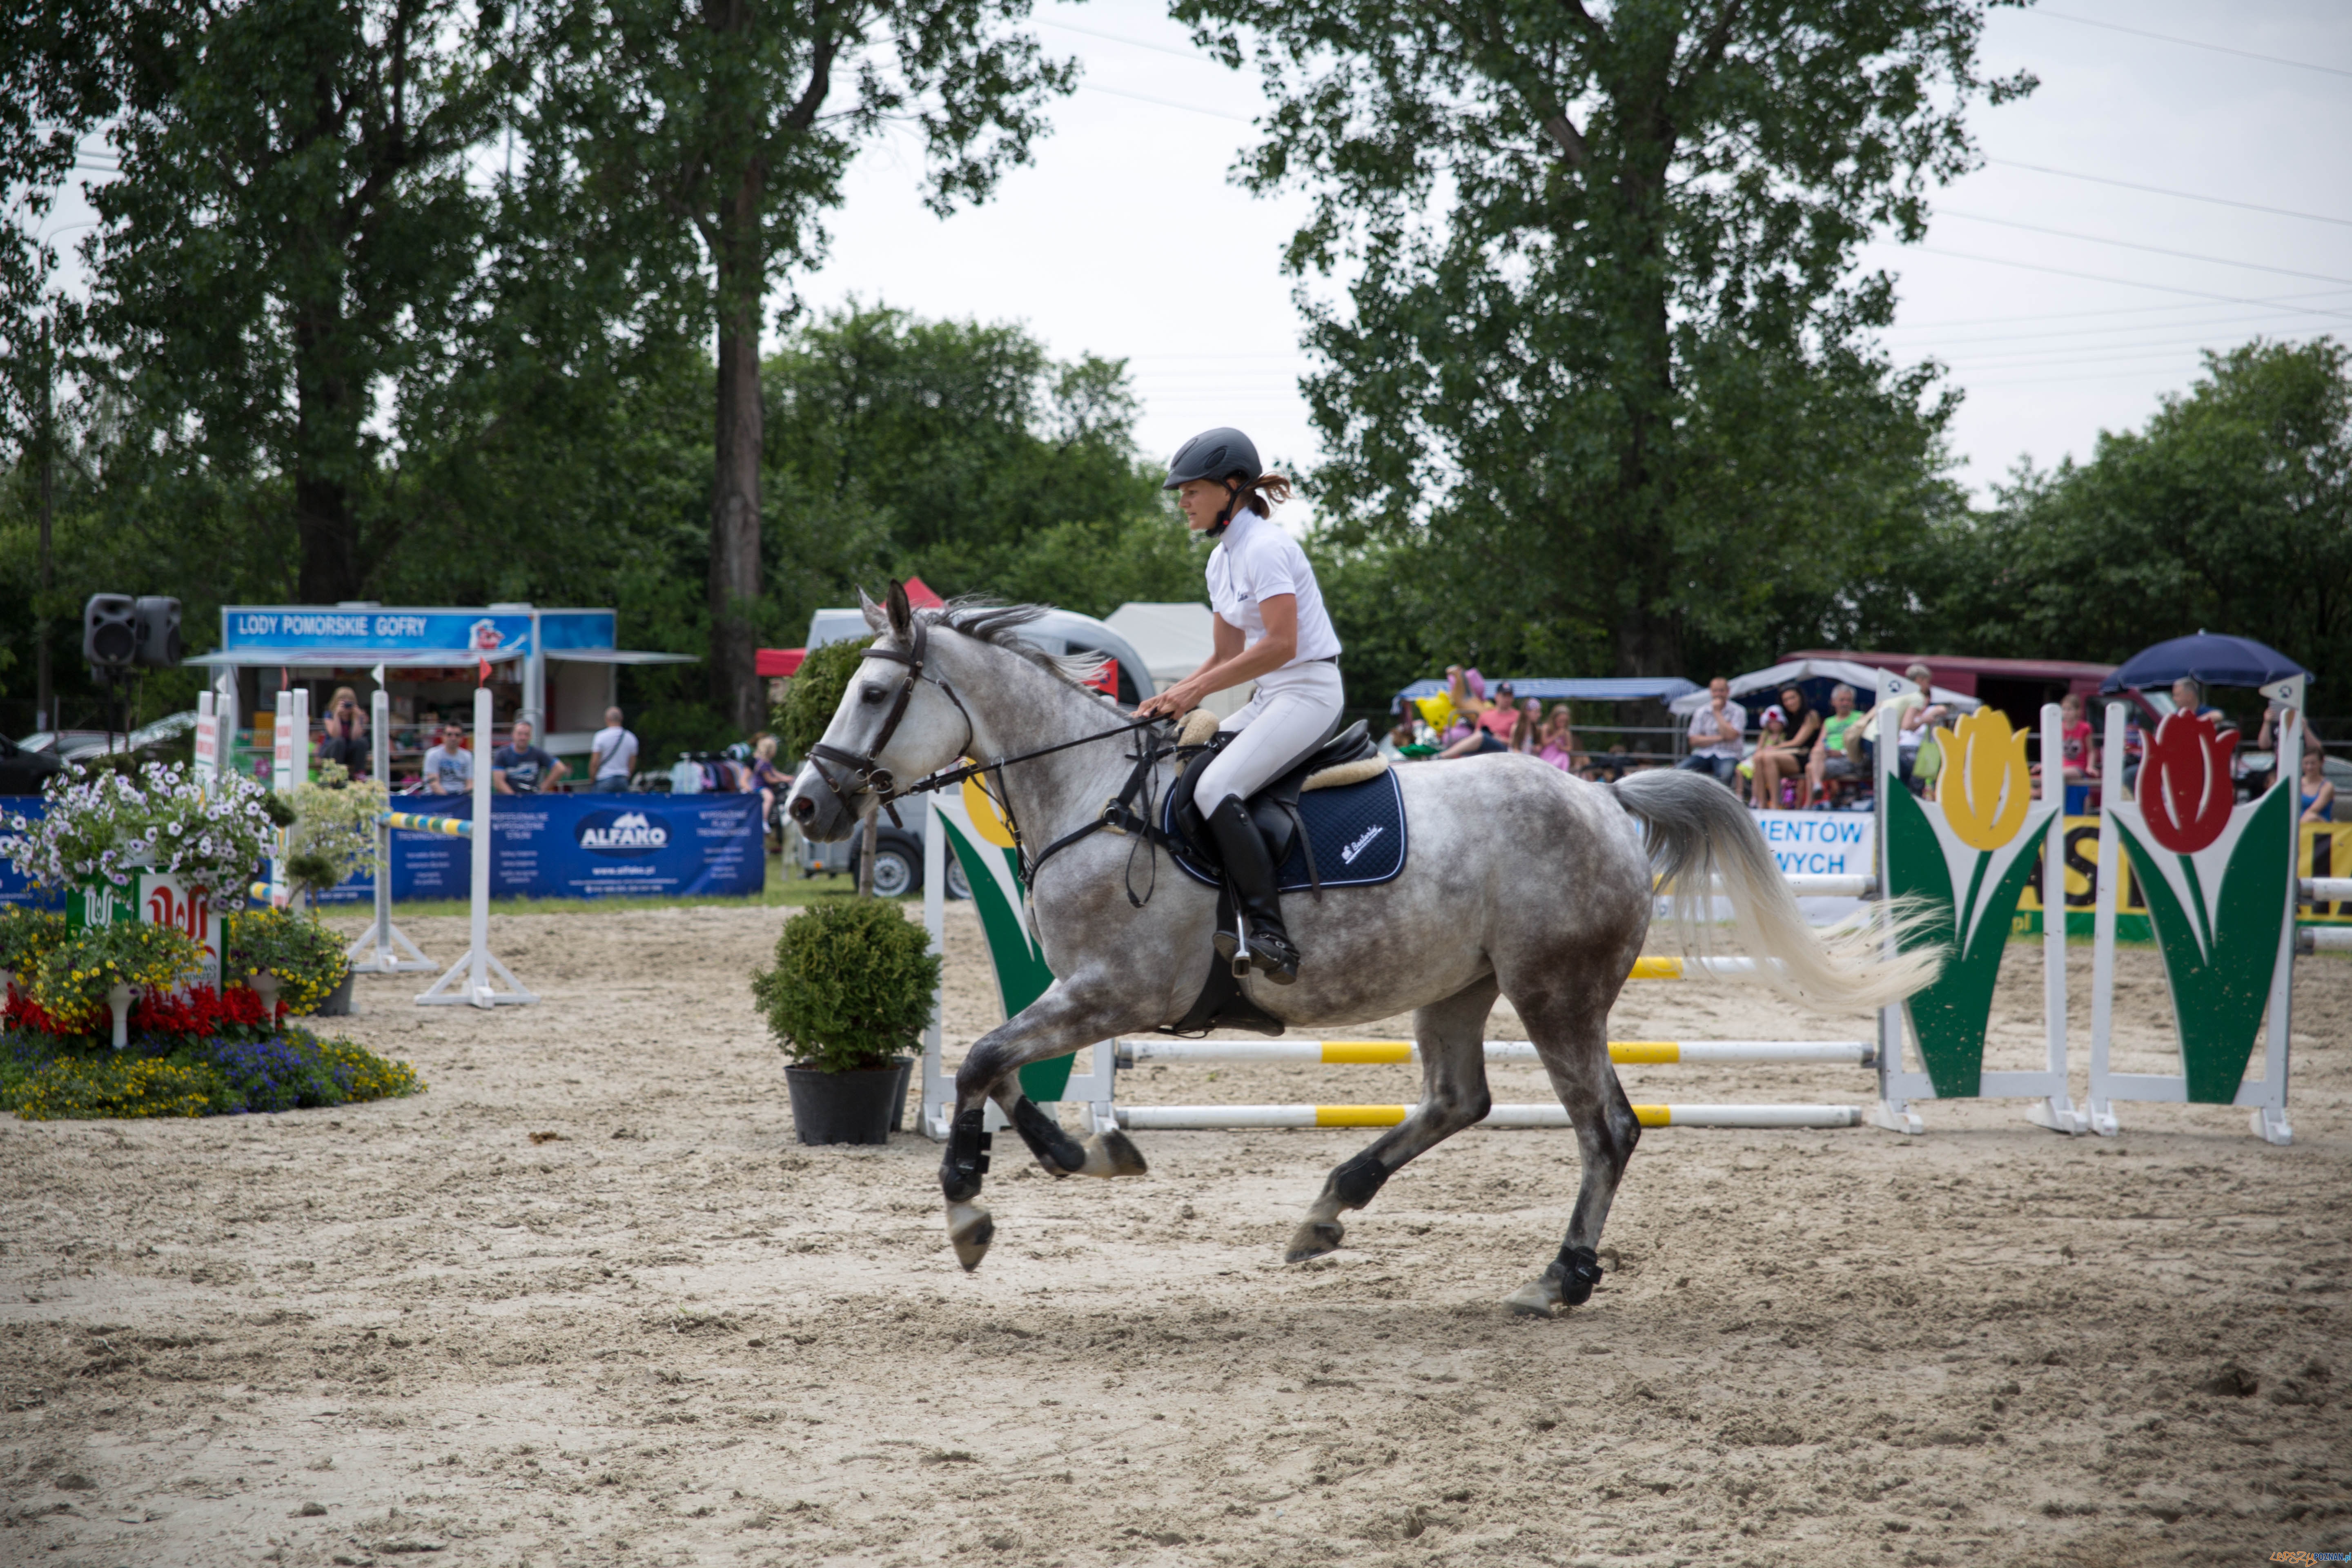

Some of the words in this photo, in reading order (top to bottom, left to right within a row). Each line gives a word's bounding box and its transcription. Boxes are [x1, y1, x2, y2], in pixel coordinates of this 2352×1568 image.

[238, 615, 278, 635] LODY
[283, 615, 368, 636] POMORSKIE
[374, 616, 427, 636] GOFRY
[580, 827, 667, 845] ALFAKO
